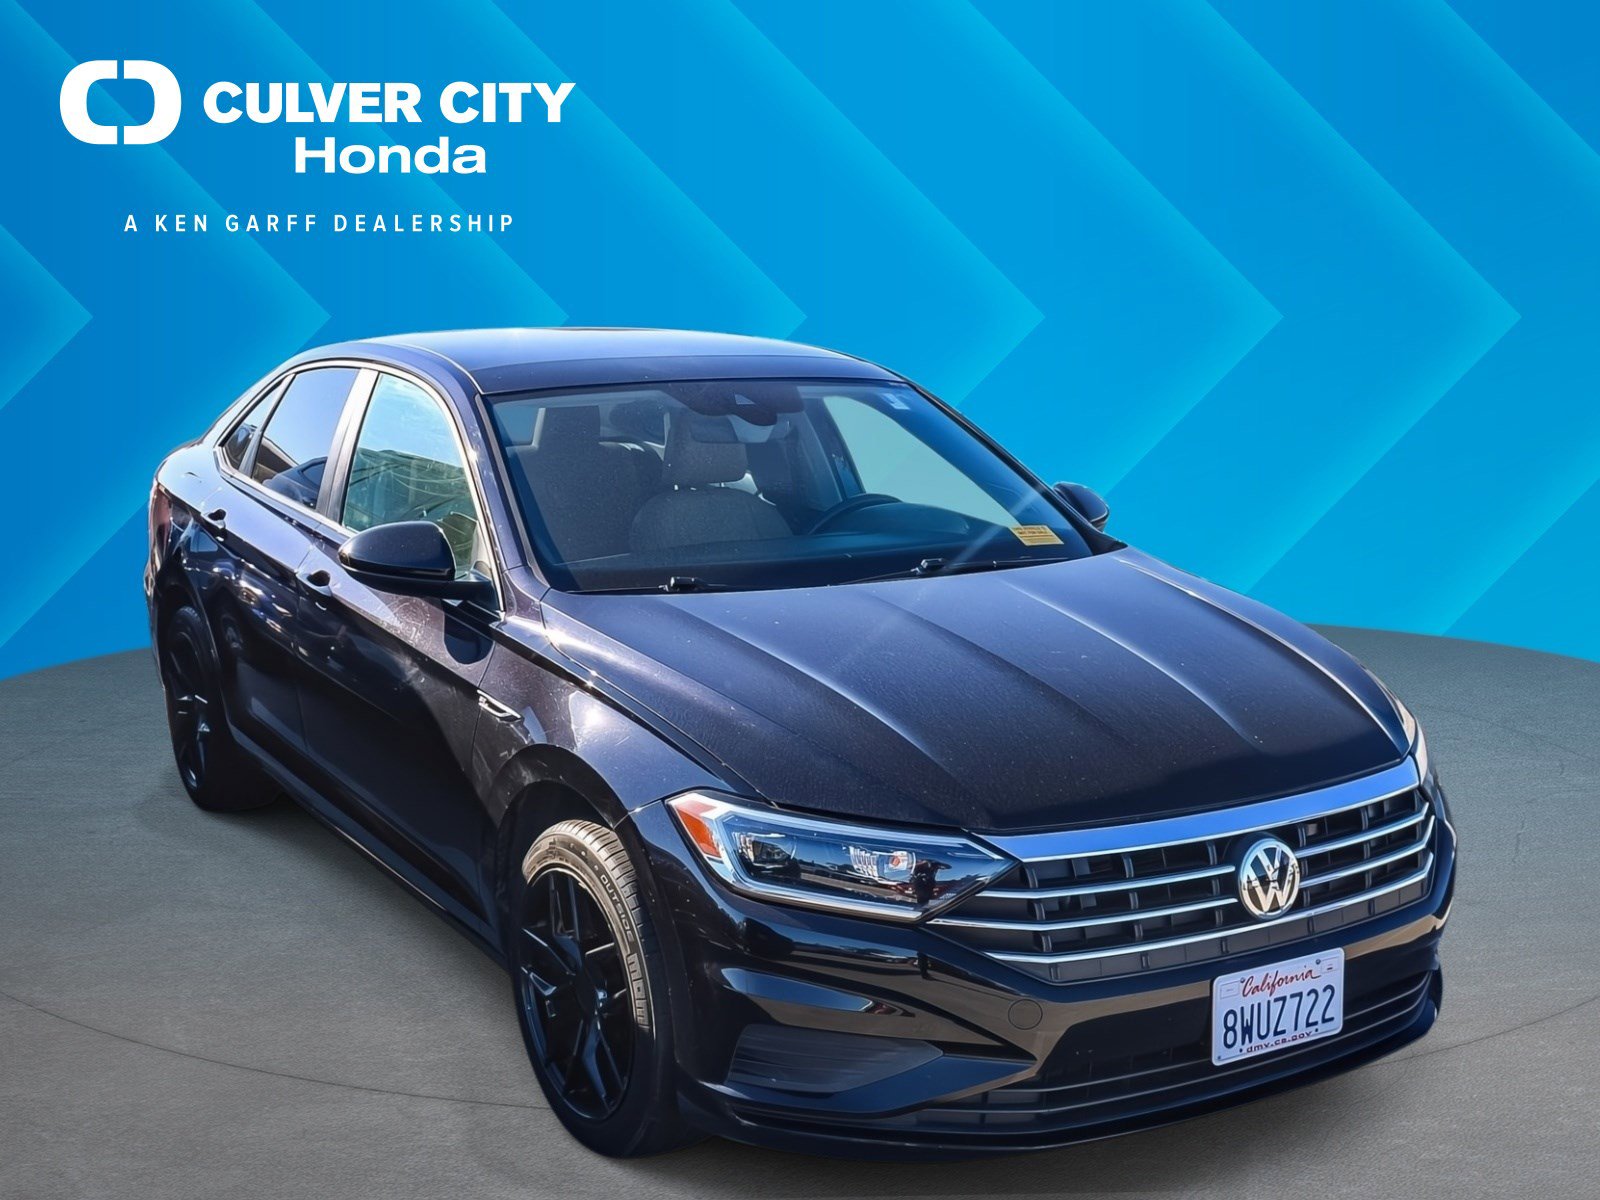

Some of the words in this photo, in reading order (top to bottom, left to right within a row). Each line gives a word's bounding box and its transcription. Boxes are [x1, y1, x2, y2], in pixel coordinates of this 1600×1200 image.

[1240, 838, 1300, 919] VW
[1241, 966, 1321, 997] California
[1223, 984, 1335, 1049] 8WUZ722
[1246, 1031, 1313, 1054] dmv.ca.gov
